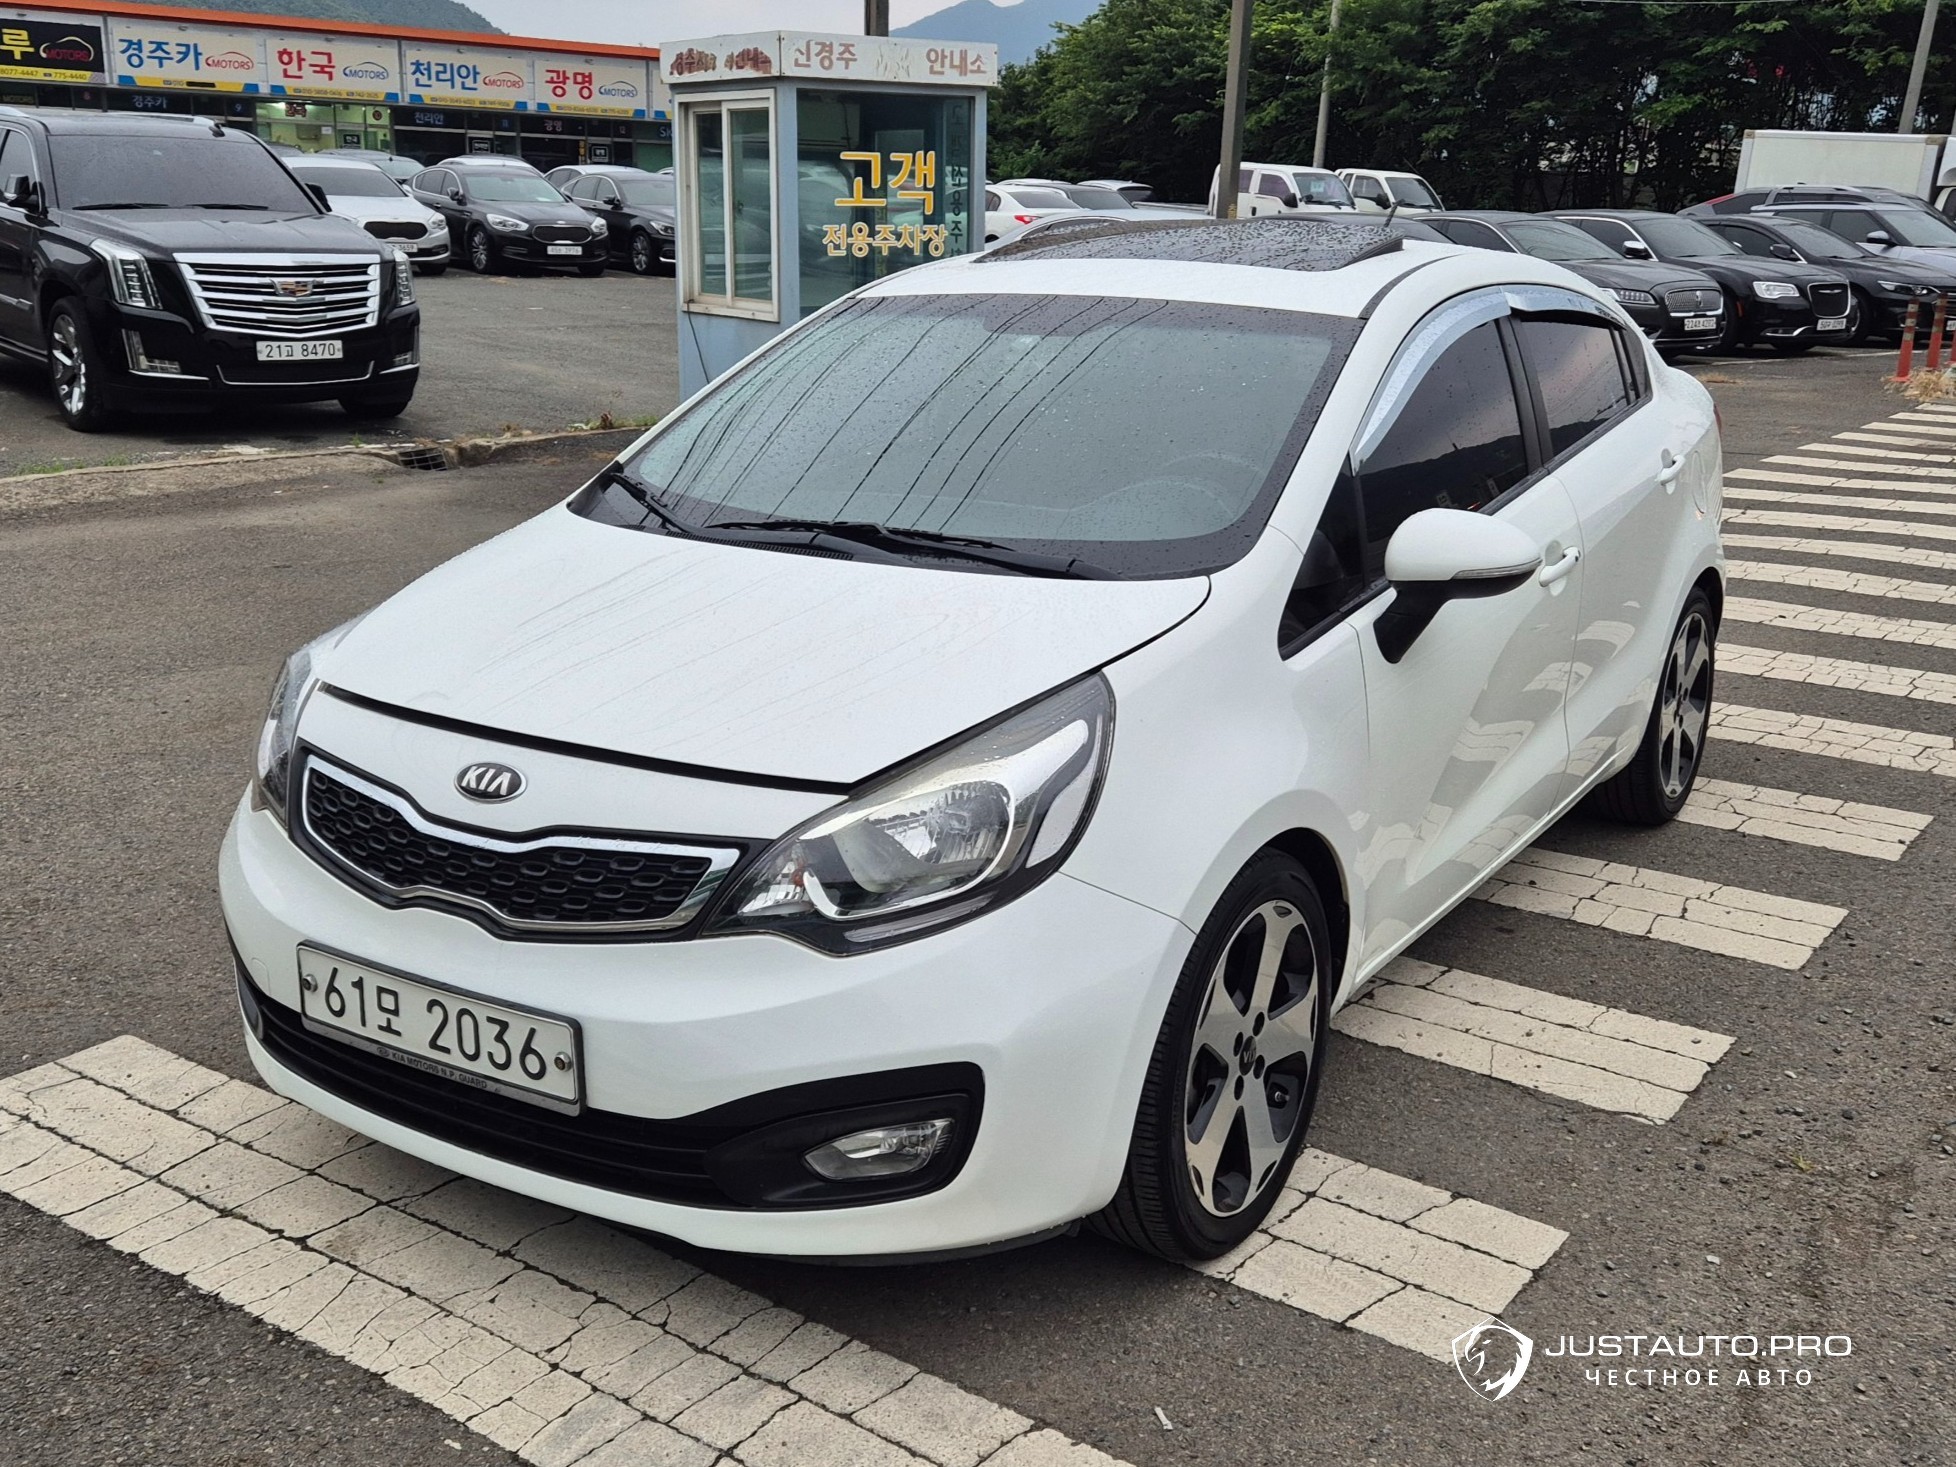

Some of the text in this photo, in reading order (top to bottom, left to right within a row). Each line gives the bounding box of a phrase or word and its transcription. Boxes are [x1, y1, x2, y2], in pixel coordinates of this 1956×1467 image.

[0, 28, 35, 60] 루
[46, 48, 90, 62] MOTORS
[119, 39, 203, 71] 경주카
[793, 39, 858, 71] 신경주
[925, 47, 987, 76] 안내소
[211, 58, 251, 71] MOTORS
[277, 48, 336, 81] 한국
[347, 69, 386, 80] MOTORS
[410, 60, 481, 91] 천리안
[488, 77, 522, 89] MOTORS
[545, 69, 594, 100] 광명
[603, 87, 636, 98] MOTORS
[834, 150, 936, 215] 고객
[822, 221, 948, 258] 전용주차장
[265, 343, 336, 358] 21고 8470
[460, 765, 513, 796] KIA
[324, 967, 547, 1081] 61모 2036
